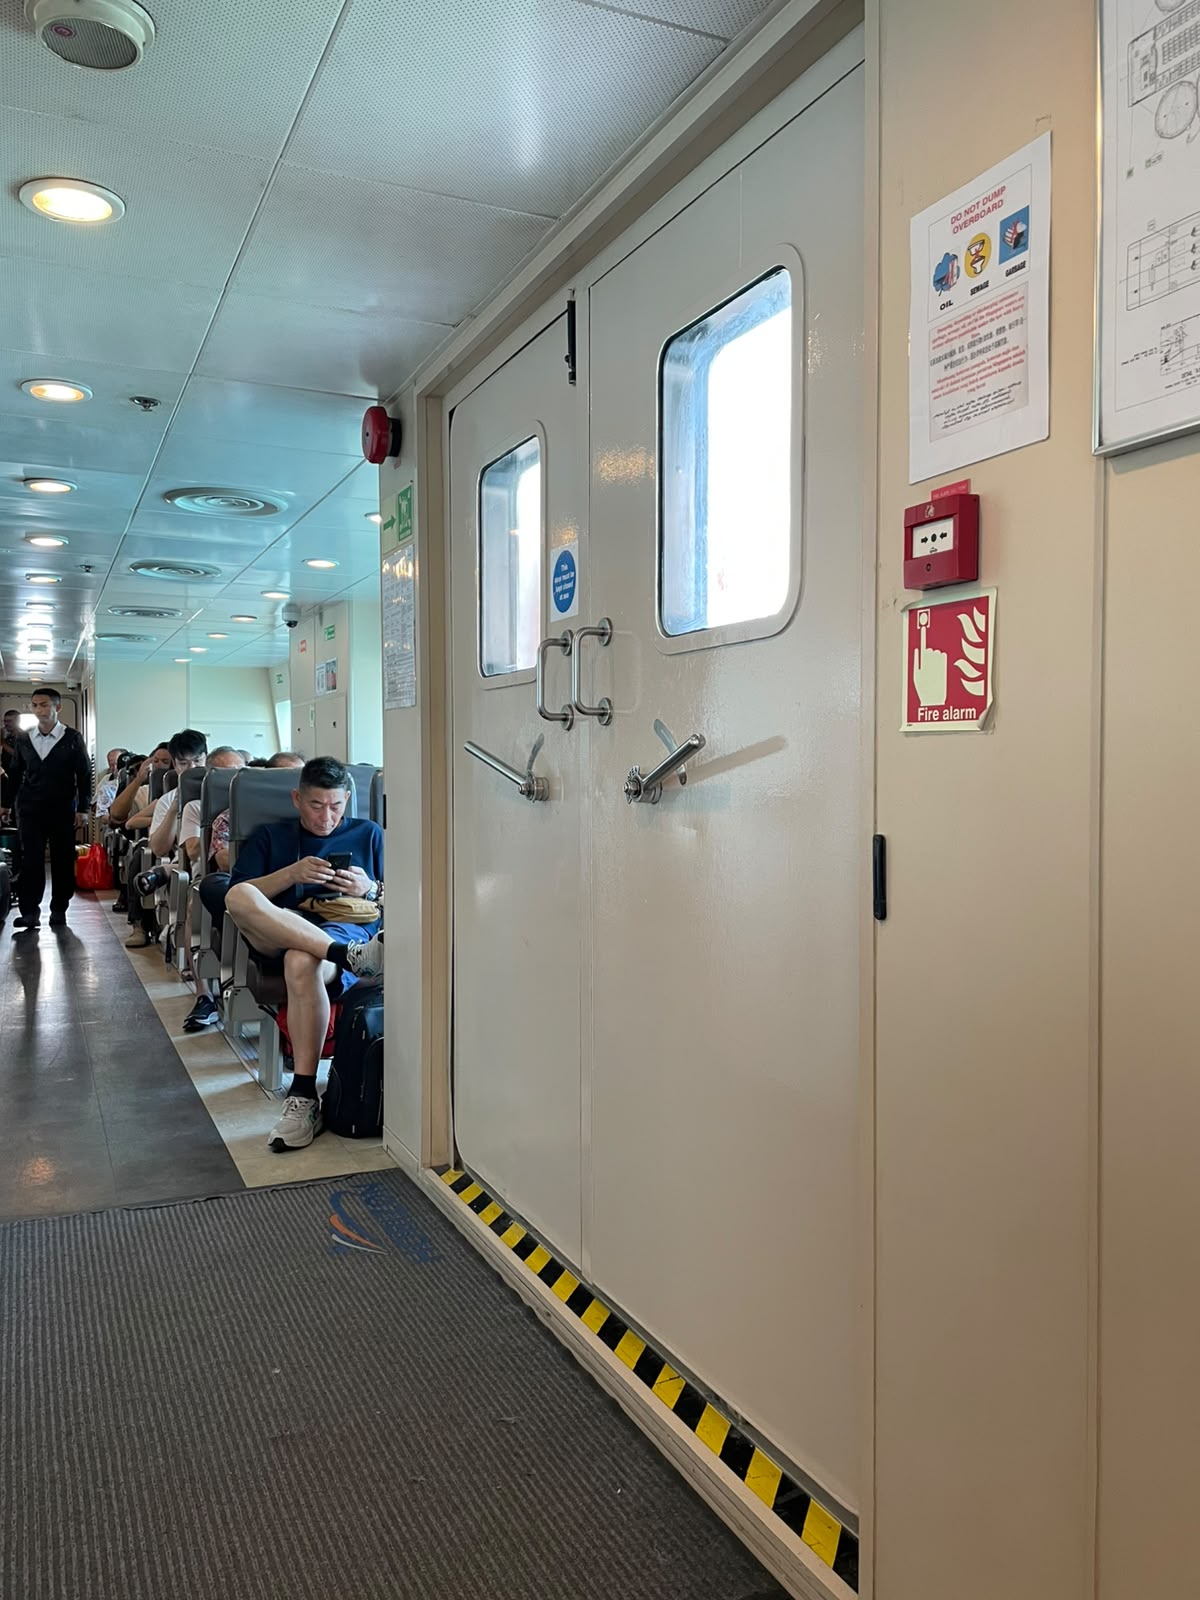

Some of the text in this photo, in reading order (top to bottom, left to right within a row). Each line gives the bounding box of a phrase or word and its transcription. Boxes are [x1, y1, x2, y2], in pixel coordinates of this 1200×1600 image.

[950, 186, 1006, 225] DO NOT DUMP
[952, 199, 1004, 235] OVERBOARD
[1005, 260, 1027, 278] GARBAGE
[970, 280, 990, 296] SEWAGE
[940, 300, 954, 311] OIL
[918, 705, 976, 721] Fire alarm
